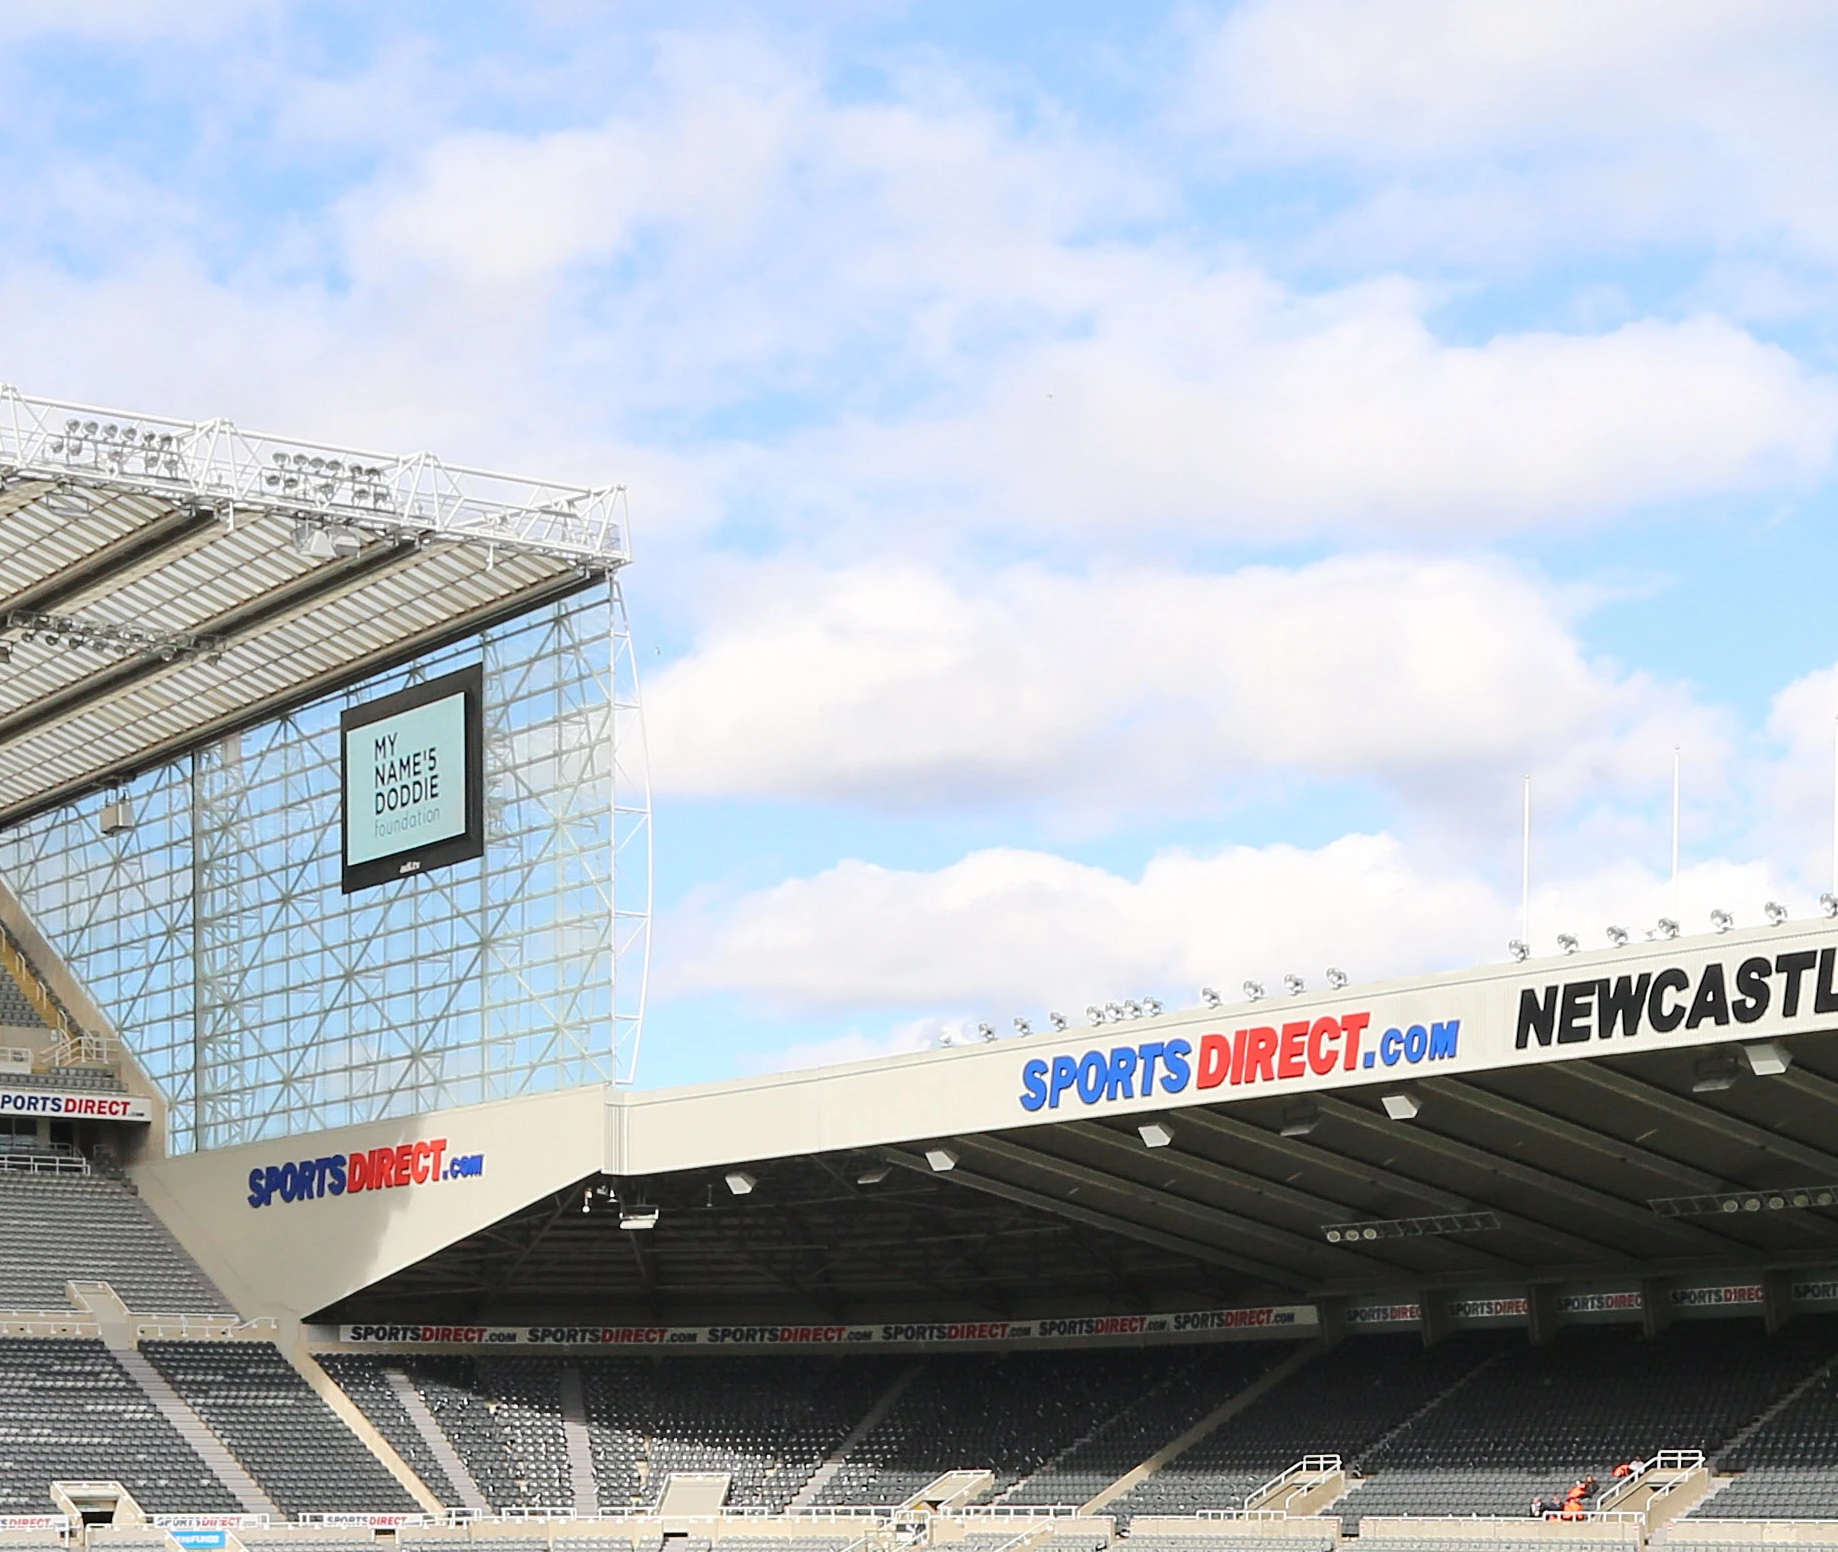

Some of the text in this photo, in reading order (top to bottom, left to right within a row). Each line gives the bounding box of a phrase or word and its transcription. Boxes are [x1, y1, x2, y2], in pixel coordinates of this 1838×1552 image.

[374, 732, 398, 762] MY
[374, 748, 438, 790] NAME'S
[374, 774, 439, 816] DODDIE
[374, 806, 441, 839] foundation
[1019, 1011, 1459, 1112] SPORTSDIRECT.COM
[1671, 1287, 1764, 1305] SPORTSDIREC
